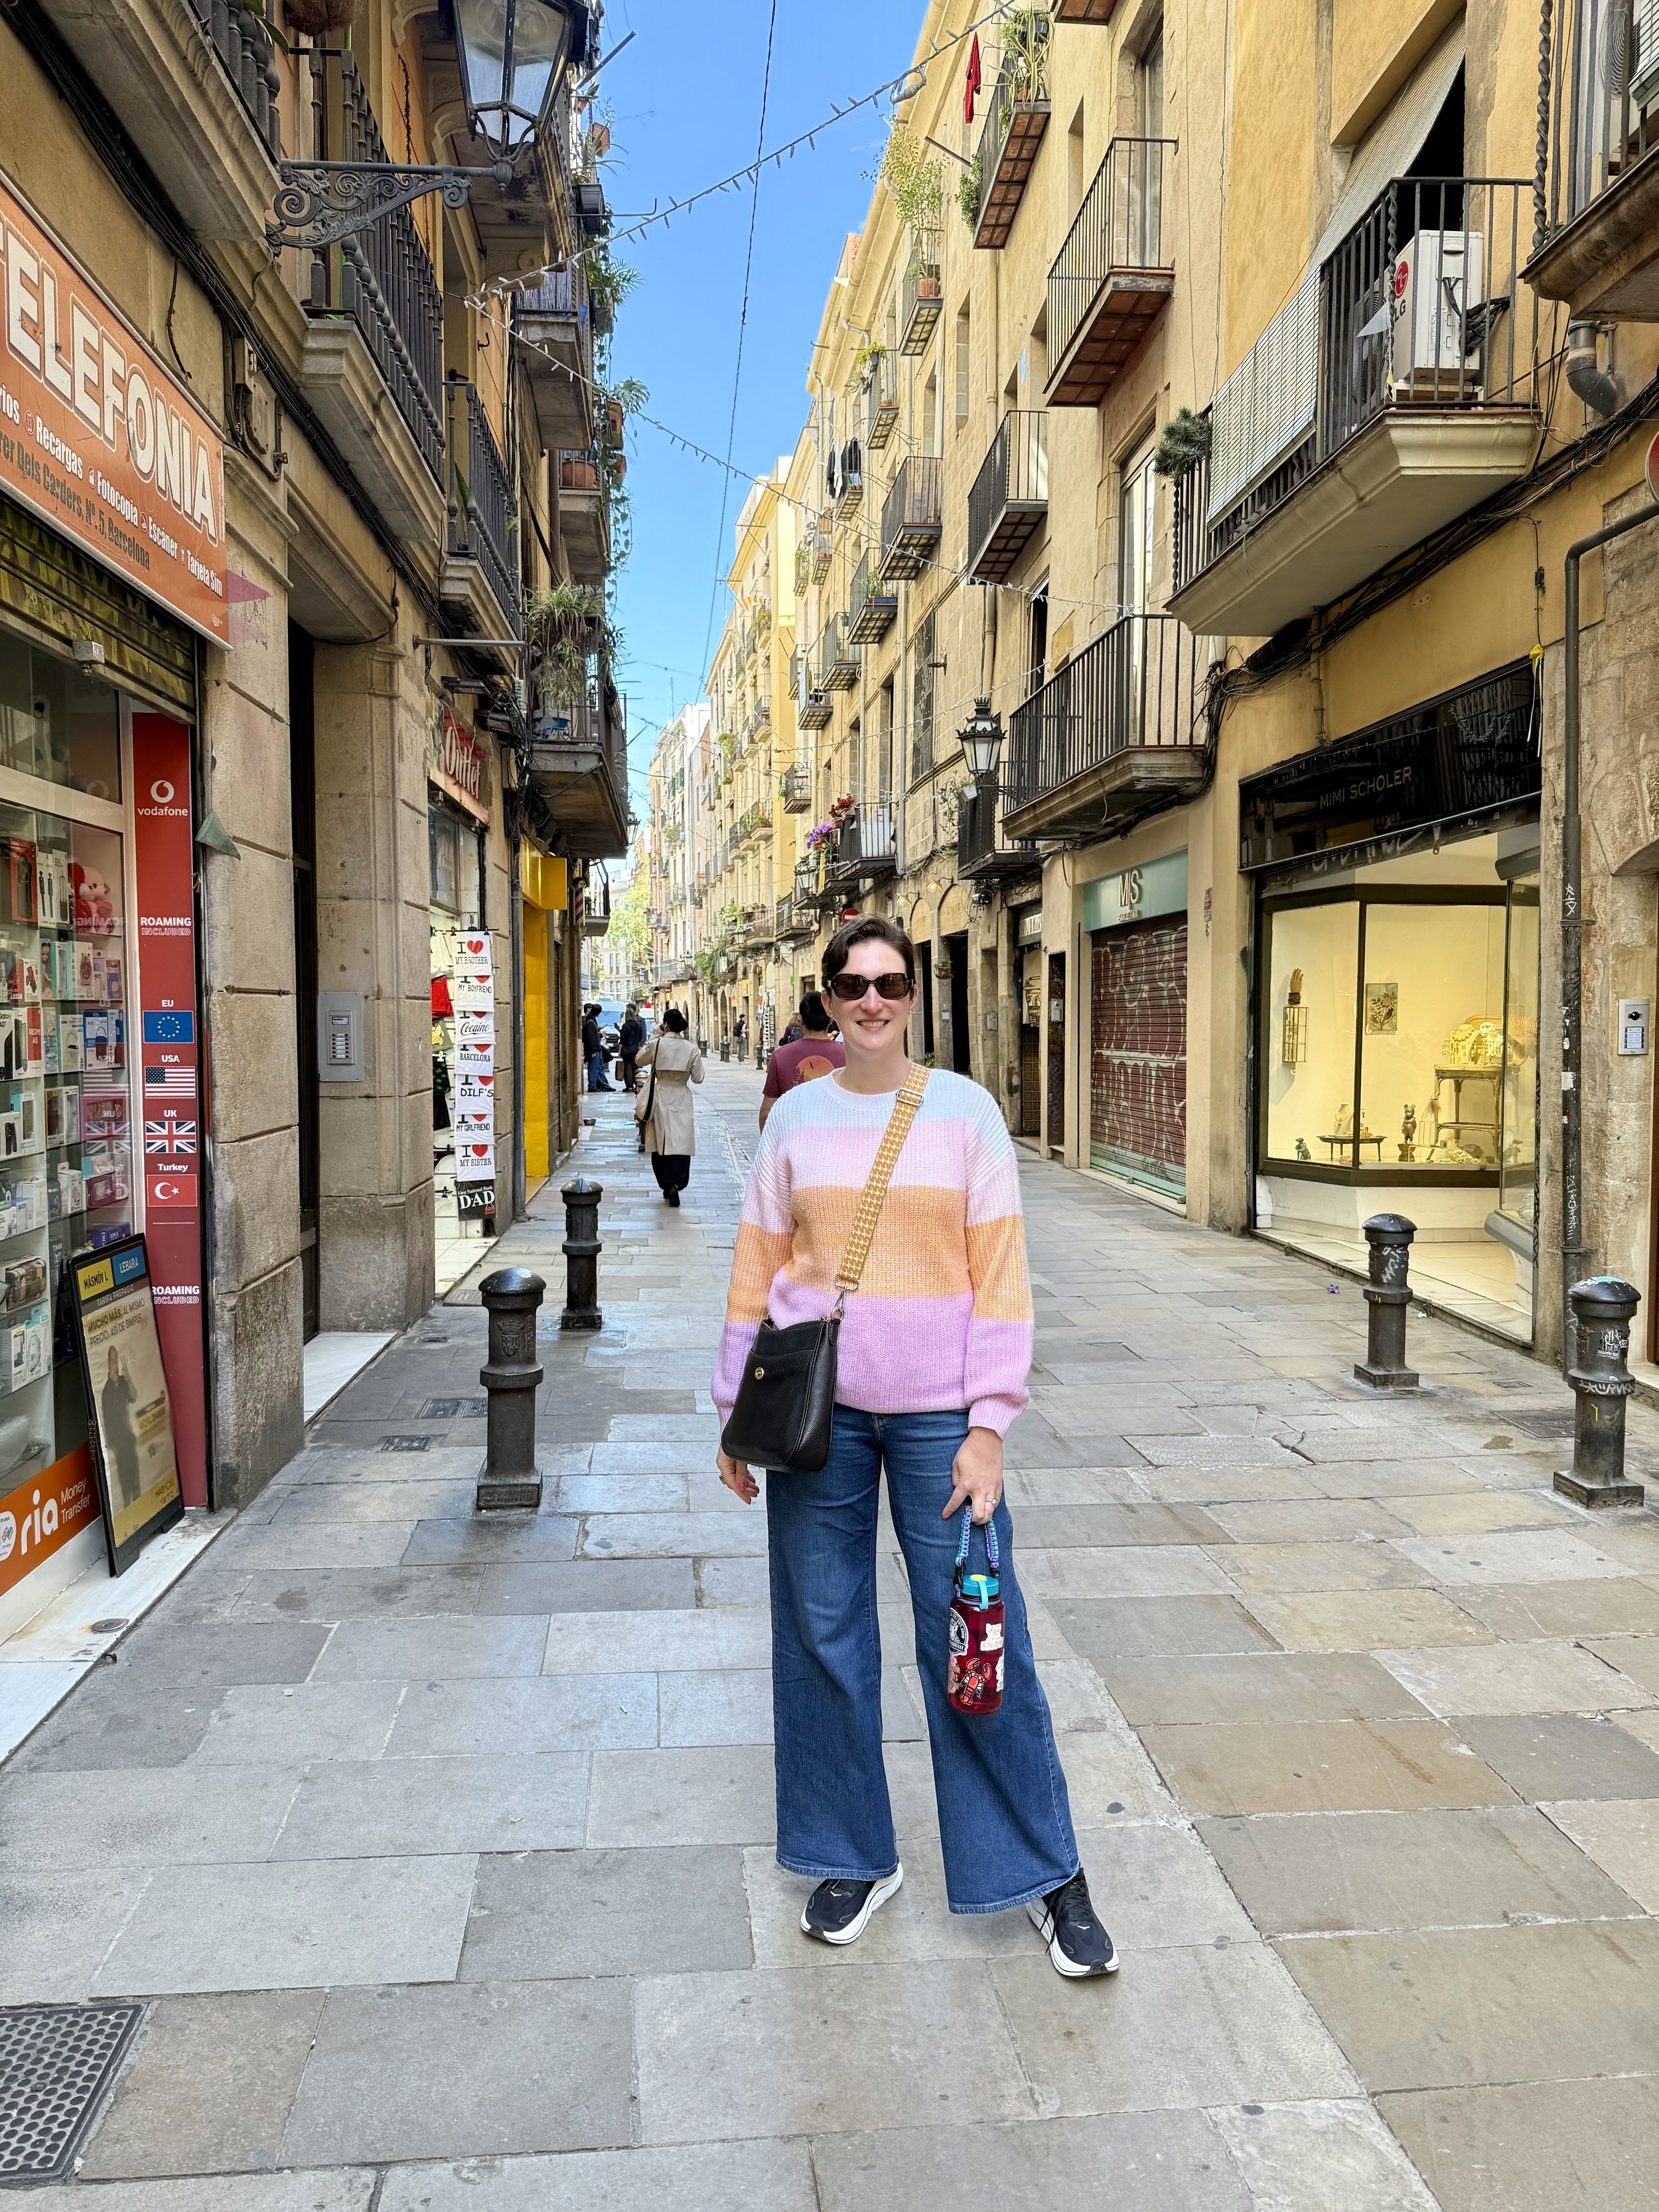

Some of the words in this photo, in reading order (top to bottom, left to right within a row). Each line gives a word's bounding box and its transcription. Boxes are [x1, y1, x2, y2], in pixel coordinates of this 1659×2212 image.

[1394, 299, 1406, 323] LG
[0, 219, 218, 540] ELEFONIA
[17, 441, 41, 484] Dels
[36, 414, 83, 480] Recargas
[97, 469, 139, 528] Fotocopia
[148, 515, 179, 560] Escáner
[186, 548, 210, 587] Tarjeta
[210, 569, 223, 598] Sim
[1320, 788, 1346, 810] MIMI
[1350, 765, 1412, 800] SCHOLER
[137, 806, 188, 816] vodafone
[141, 917, 192, 926] ROAMING
[141, 927, 191, 936] INCLUDED
[457, 941, 467, 954] I
[465, 956, 488, 965] BROTHER
[468, 983, 492, 994] BOYFRIEND
[460, 1021, 490, 1036] Cocaine
[161, 1054, 180, 1063] USA
[460, 1053, 491, 1062] BARCELONA
[460, 1088, 494, 1098] DILF'S
[464, 1123, 490, 1132] GIRLFRIEND
[461, 1145, 471, 1157] I
[157, 1163, 188, 1173] Turkey
[470, 1158, 492, 1167] SISTER
[119, 1256, 139, 1274] LEBARA
[96, 1293, 113, 1307] TARIFA
[113, 1284, 135, 1300] PREPAGO
[154, 1295, 200, 1305] NCLUDED
[88, 1315, 109, 1333] MUCHO
[123, 1307, 129, 1315] AL
[129, 1297, 145, 1313] MISMO
[90, 1330, 111, 1347] PRECIO.
[118, 1322, 125, 1333] DE
[125, 1313, 142, 1328] SIMPLE
[61, 1478, 86, 1506] Money
[61, 1494, 91, 1524] Transfer
[21, 1489, 58, 1556] ria
